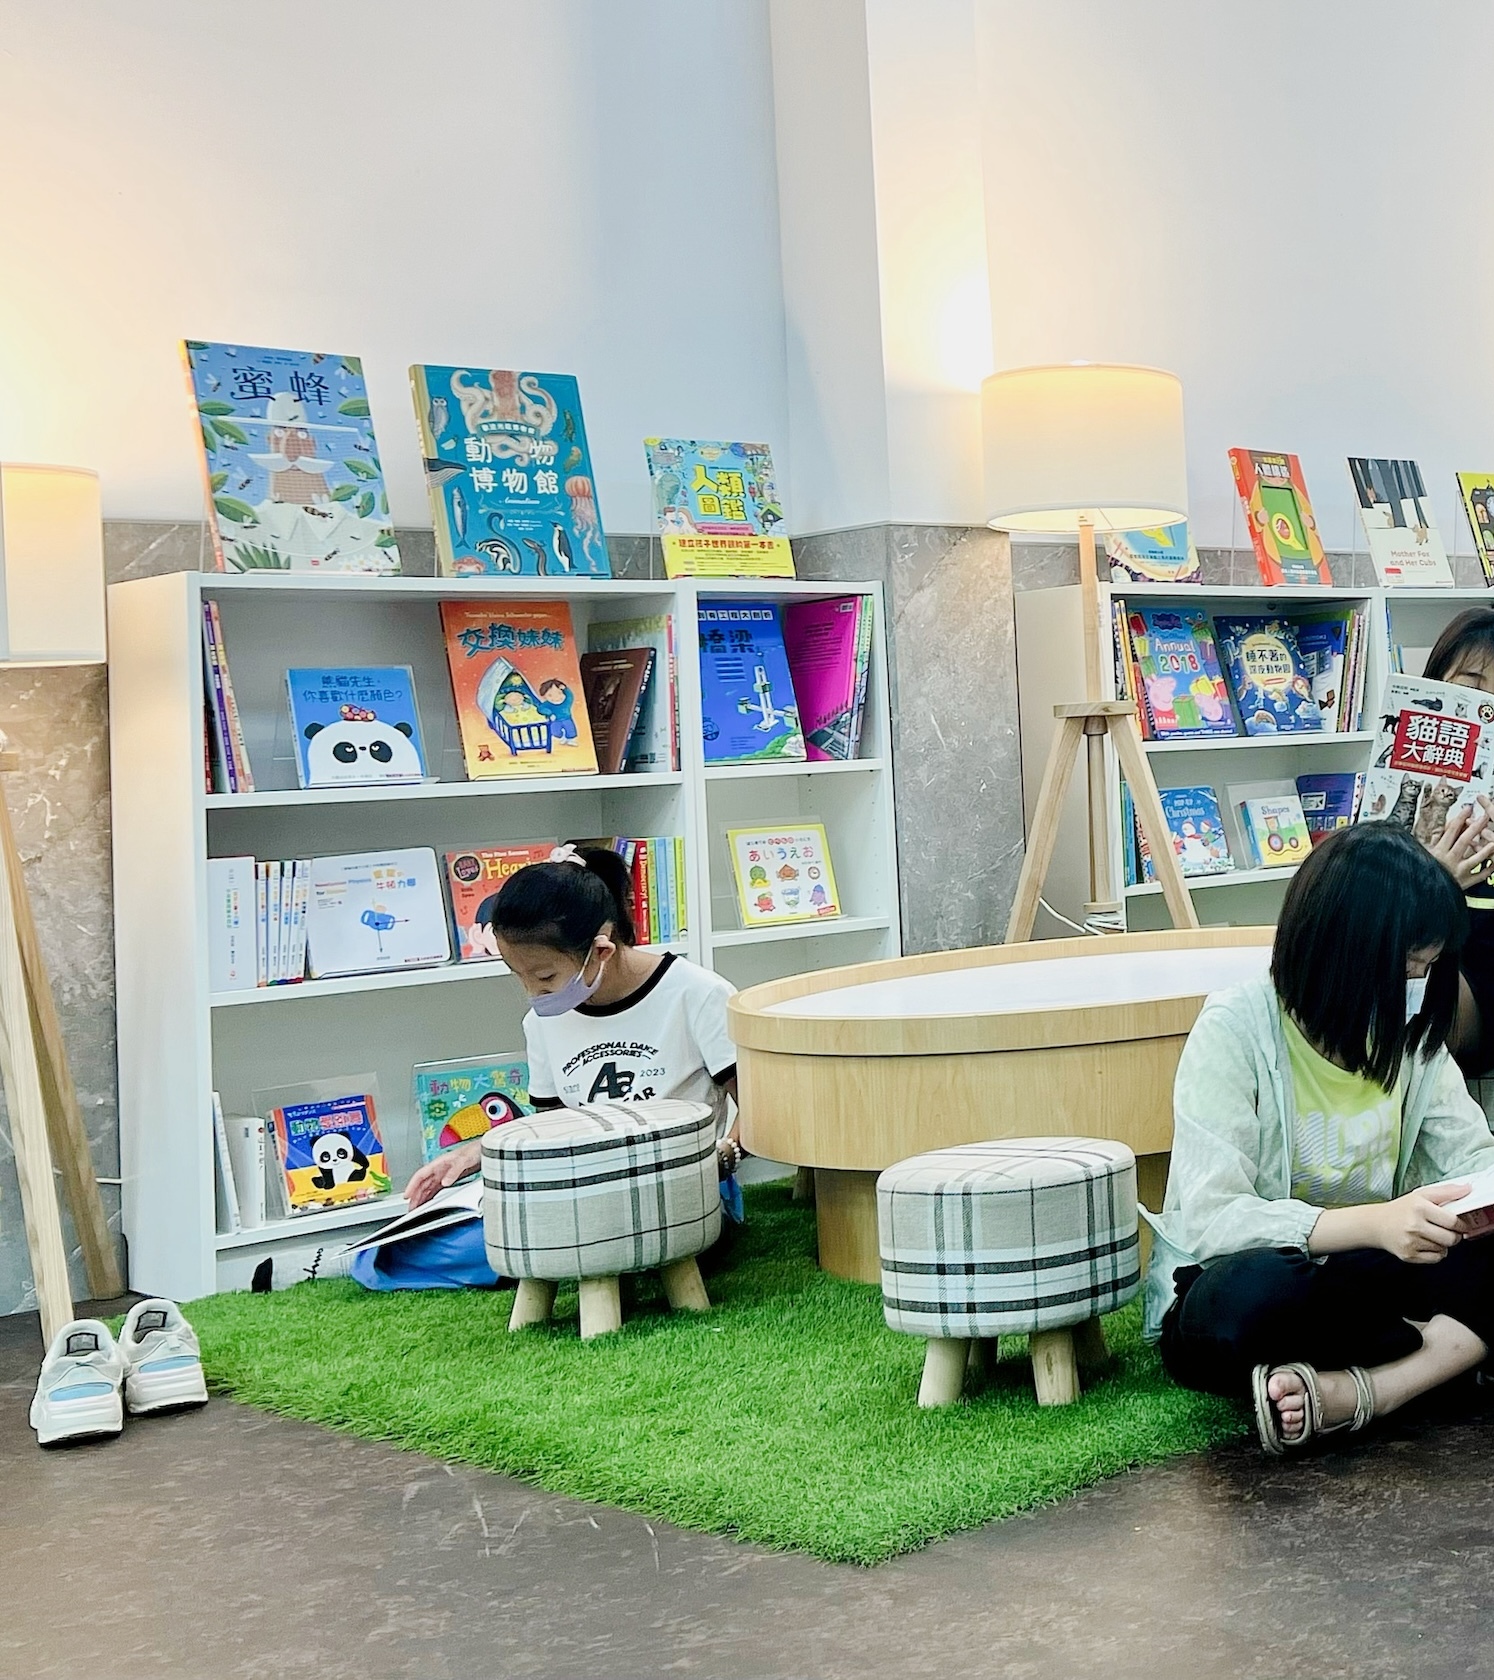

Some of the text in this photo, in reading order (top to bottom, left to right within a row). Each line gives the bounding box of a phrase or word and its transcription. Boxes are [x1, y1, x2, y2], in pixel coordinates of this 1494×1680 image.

[229, 364, 334, 407] 蜜蜂
[464, 436, 556, 466] 動物
[469, 466, 560, 496] 博物館
[1390, 550, 1431, 558] Mother Fox
[457, 621, 565, 658] 交換妹妹
[1154, 637, 1196, 652] Annual
[1159, 653, 1199, 673] 2018
[1405, 714, 1471, 749] 貓語
[1400, 741, 1466, 770] 大辭典
[1165, 805, 1206, 819] Christmas
[1260, 806, 1291, 816] Shapes
[748, 846, 815, 862] あいうえお
[562, 1041, 627, 1075] PROFESSIONAL
[583, 1049, 643, 1067] ACCESSORIES
[429, 1069, 523, 1097] 動物大驚奇
[639, 1067, 666, 1078] 2023
